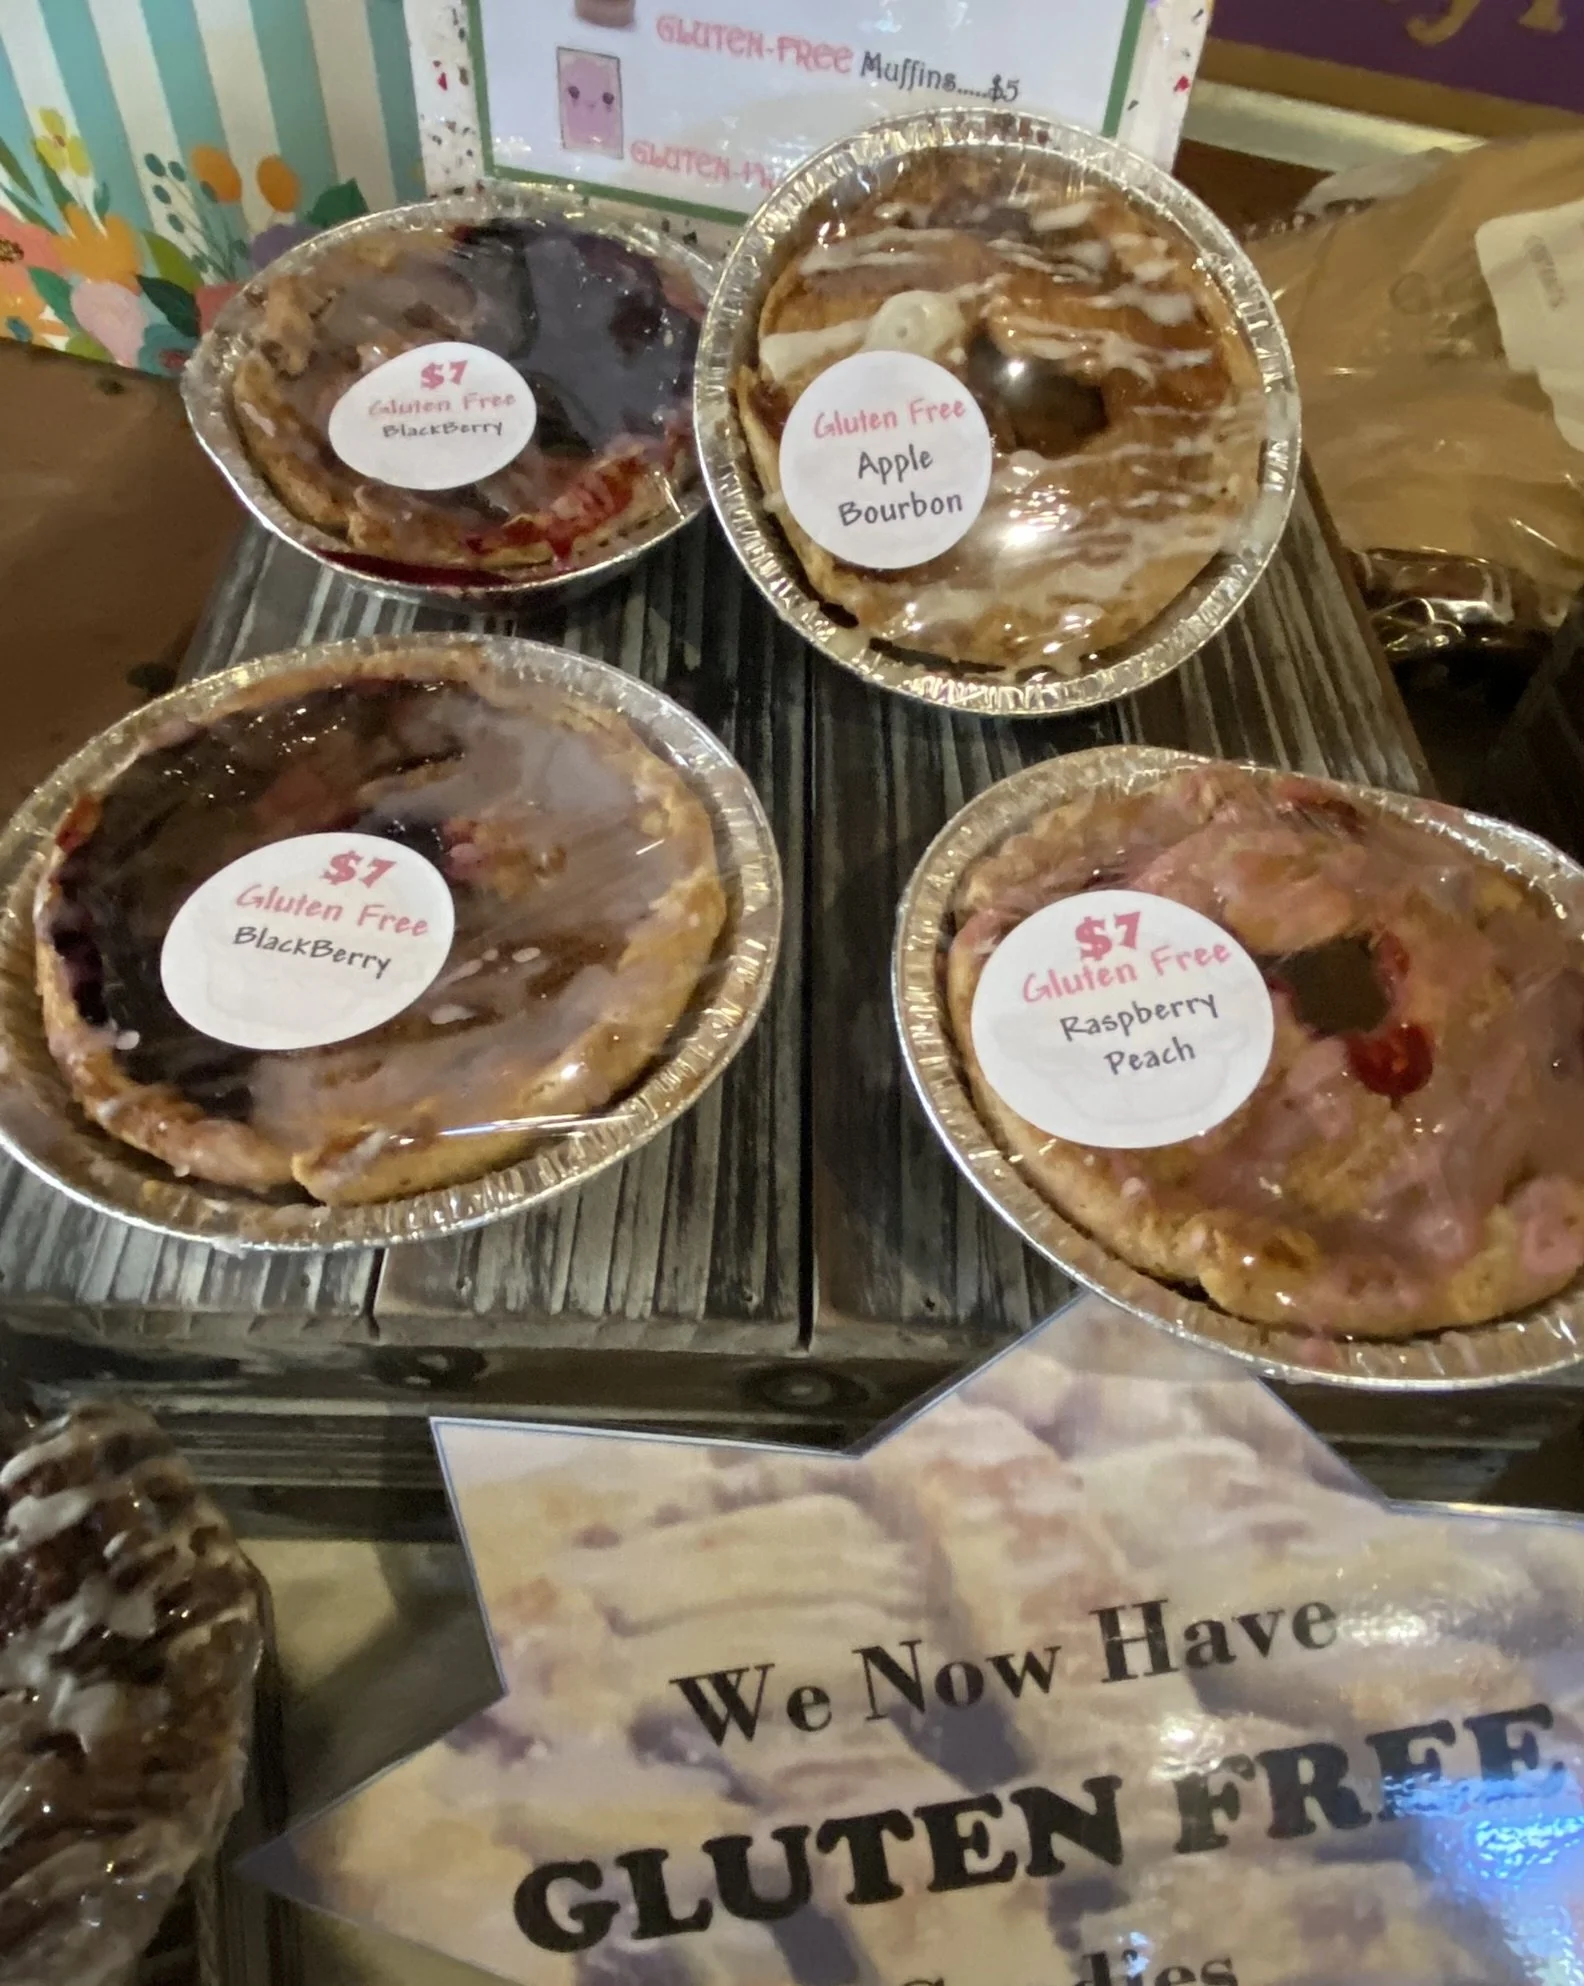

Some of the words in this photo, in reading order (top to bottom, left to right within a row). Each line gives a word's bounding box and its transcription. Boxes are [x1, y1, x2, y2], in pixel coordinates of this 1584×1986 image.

[420, 360, 468, 390] $7
[368, 399, 451, 417] Gluten
[463, 392, 516, 411] Free
[813, 408, 898, 439] Gluten
[908, 397, 967, 425] Free
[382, 421, 503, 438] BlackBerry
[858, 443, 933, 485] Apple
[838, 491, 963, 527] Bourbon
[319, 850, 397, 888] $7
[235, 884, 344, 921] Gluten
[357, 904, 428, 937] Free
[232, 926, 391, 979] BlackBerry
[1074, 911, 1142, 962] $7
[1023, 962, 1138, 1003] Gluten
[1151, 943, 1232, 976] Free
[1060, 994, 1219, 1042] Raspberry
[1104, 1036, 1196, 1076] Peach
[669, 1663, 833, 1747] We
[852, 1639, 1061, 1721] Now
[1089, 1599, 1337, 1684] Have
[513, 1774, 1123, 1953] GLUTEN
[1172, 1703, 1567, 1854] FREE
